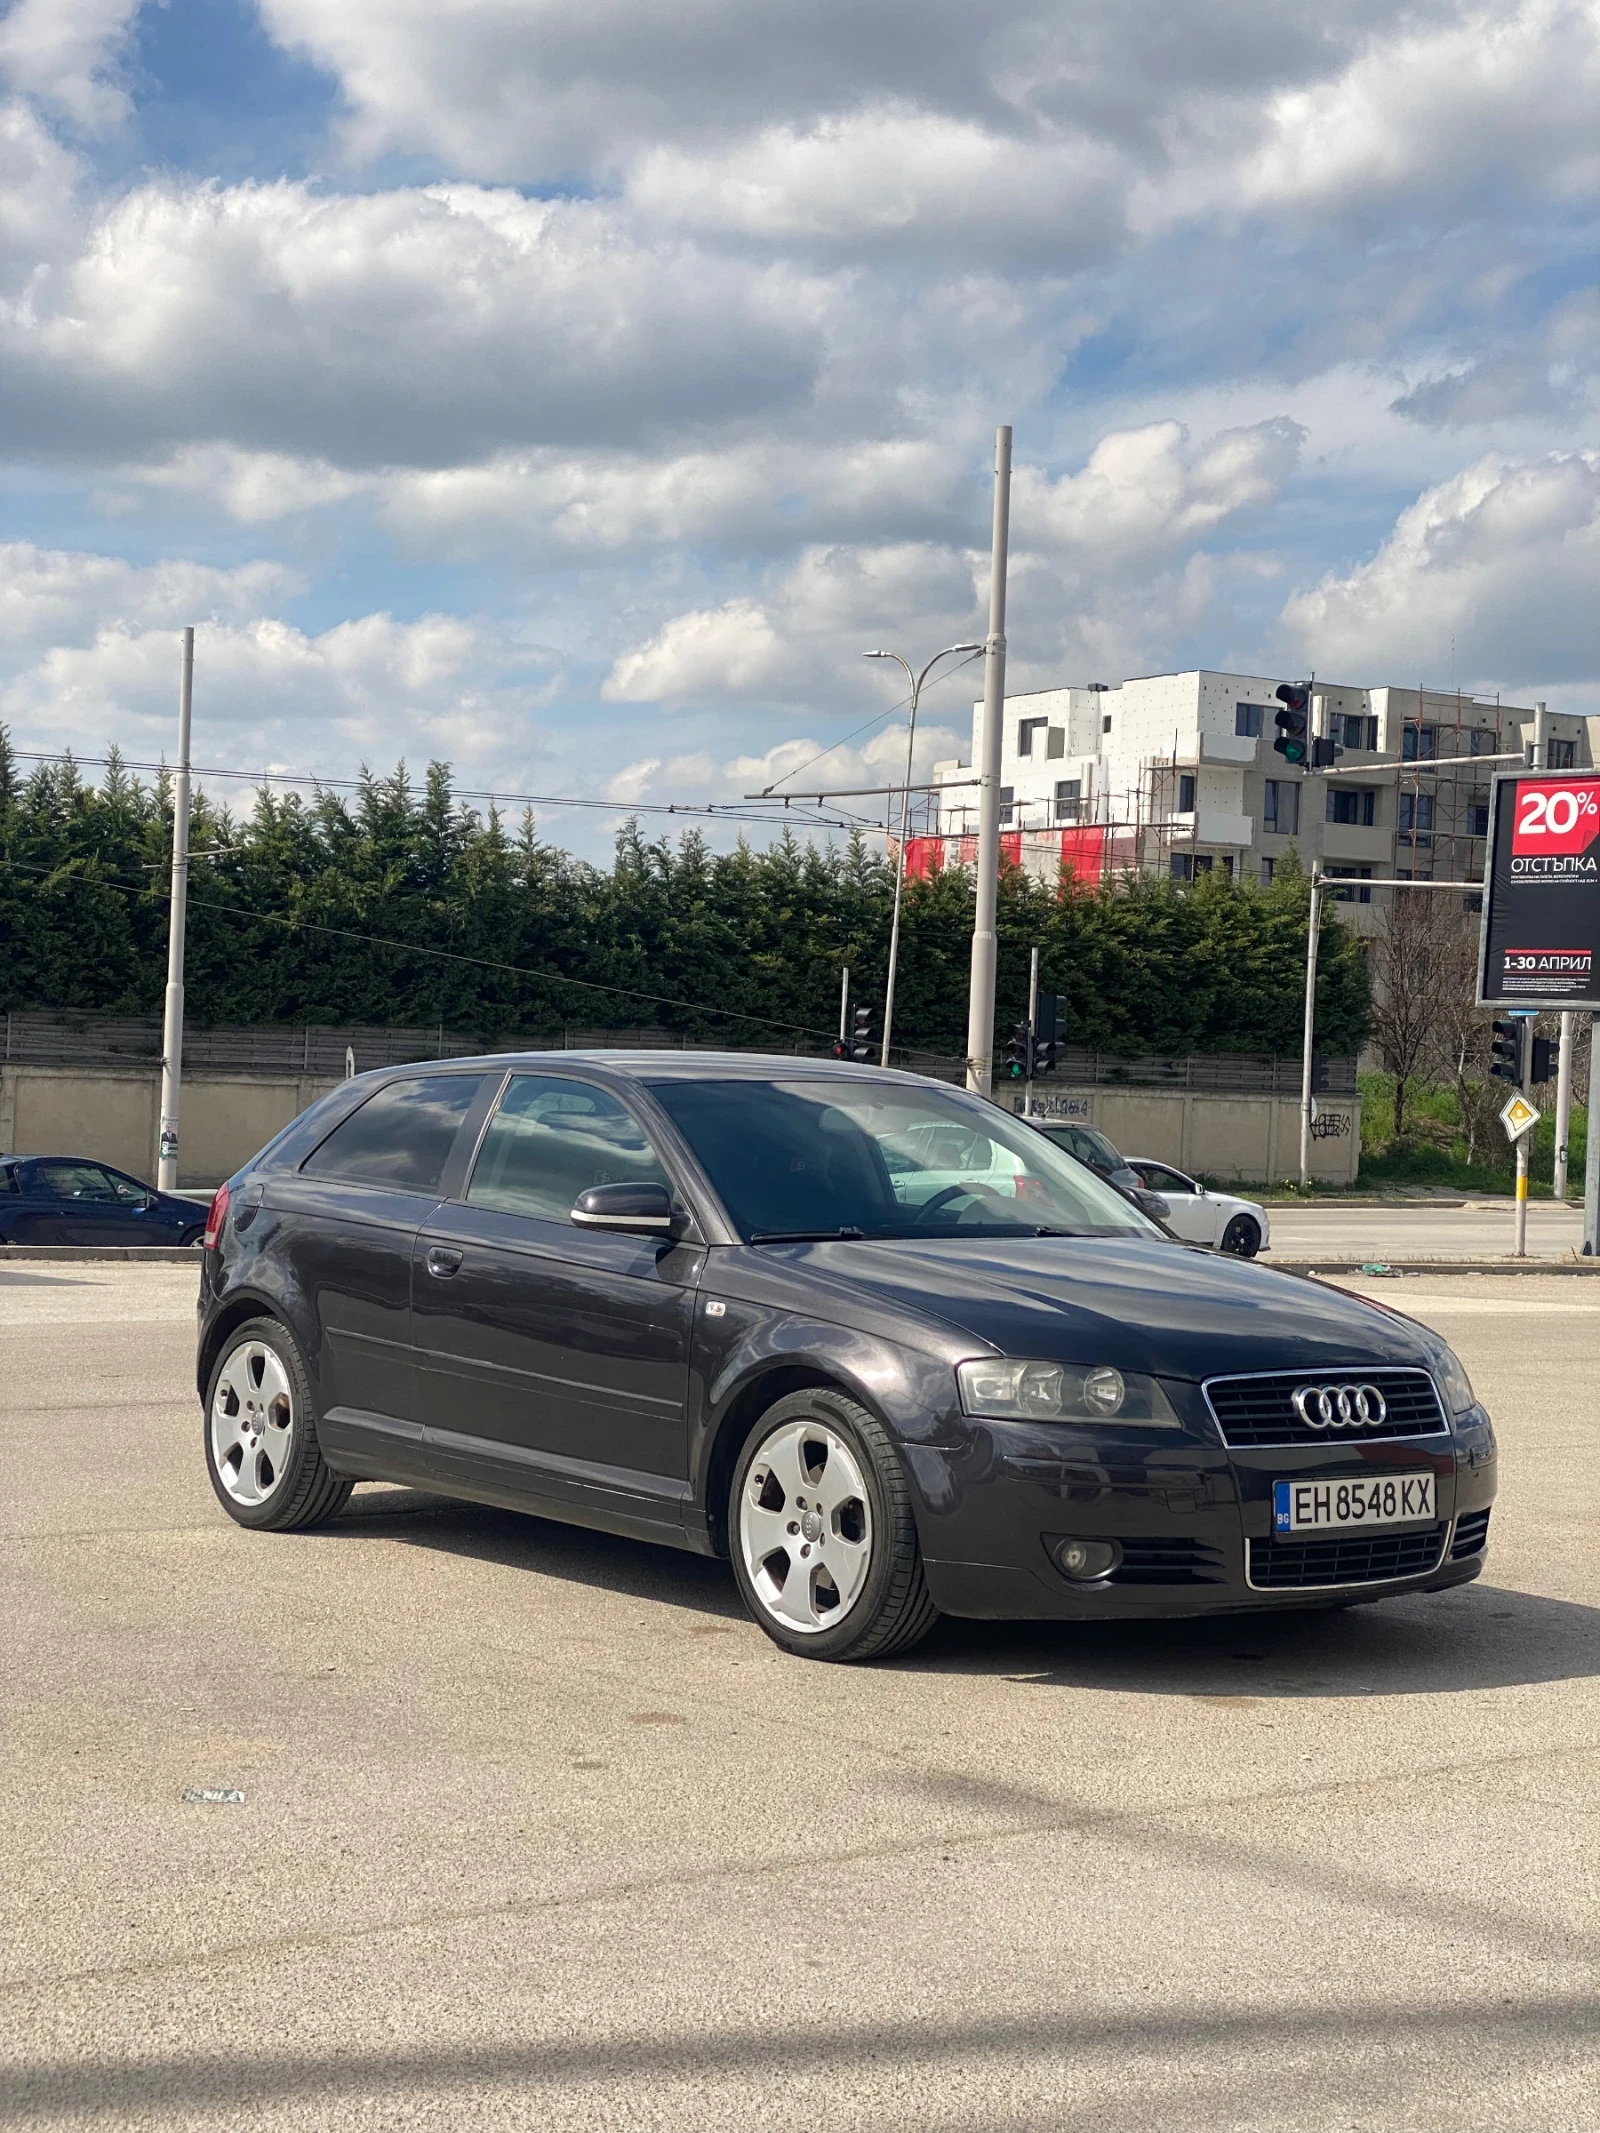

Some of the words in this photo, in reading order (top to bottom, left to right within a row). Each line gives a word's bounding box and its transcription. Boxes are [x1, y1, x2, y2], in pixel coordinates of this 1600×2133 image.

[1518, 791, 1598, 835] 20%
[1511, 857, 1597, 873] ОТСТЪПКА
[1503, 956, 1536, 970] 1-30
[1538, 956, 1592, 971] АПРИЛ
[1295, 1485, 1331, 1524] EH
[1336, 1481, 1396, 1521] 8548
[1401, 1478, 1431, 1516] KX
[1277, 1512, 1290, 1525] BG
